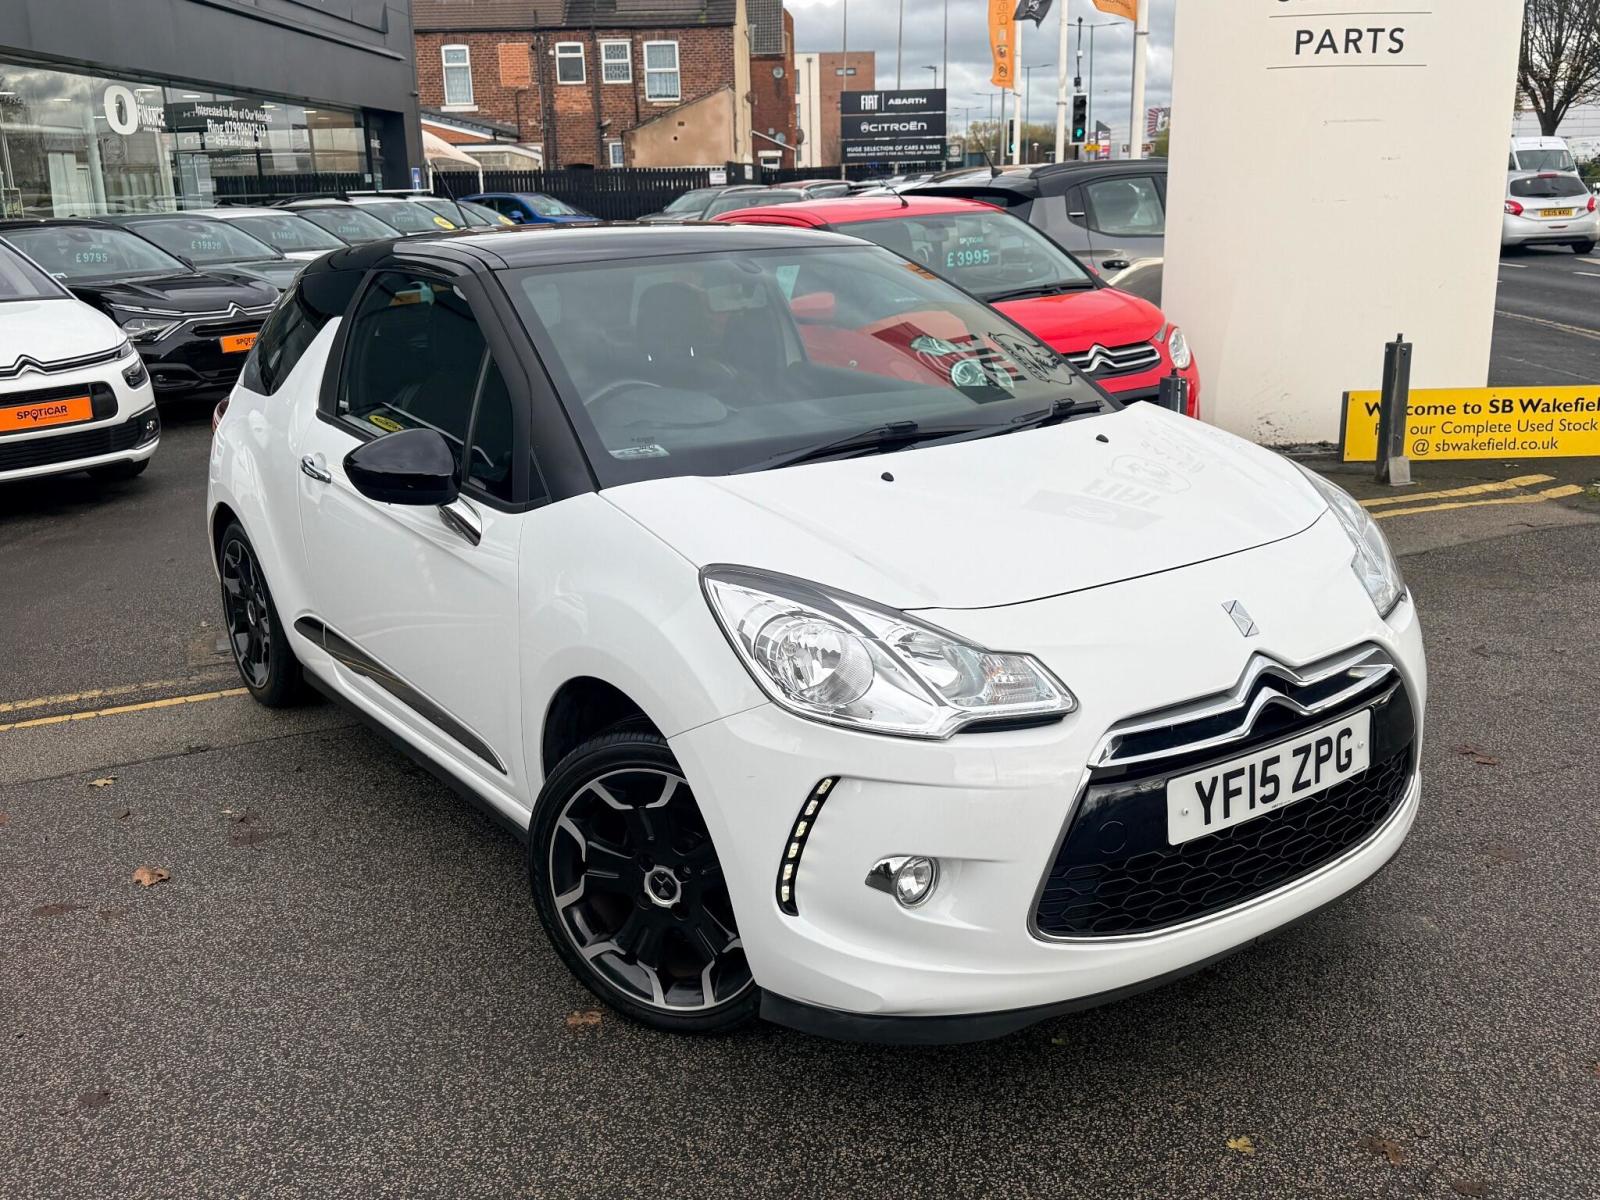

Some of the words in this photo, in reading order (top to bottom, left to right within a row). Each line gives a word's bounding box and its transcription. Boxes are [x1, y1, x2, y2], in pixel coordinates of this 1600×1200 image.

[1295, 28, 1405, 55] PARTS
[860, 94, 878, 110] FIAT
[137, 104, 165, 126] FINANCE
[207, 119, 224, 137] Ring
[76, 253, 108, 263] £9795
[946, 249, 989, 267] £3995
[1365, 402, 1456, 416] Wcome
[1463, 403, 1482, 415] to
[1489, 399, 1513, 414] SB
[1519, 397, 1600, 413] Wakefiel
[1410, 424, 1435, 435] our
[1441, 421, 1512, 438] Complete
[1518, 419, 1553, 432] Used
[1559, 418, 1597, 431] Stock
[1412, 438, 1429, 456] @
[1435, 437, 1558, 452] sbwakefield.co.uk
[1194, 755, 1280, 825] YF15
[1292, 728, 1352, 794] ZPG
